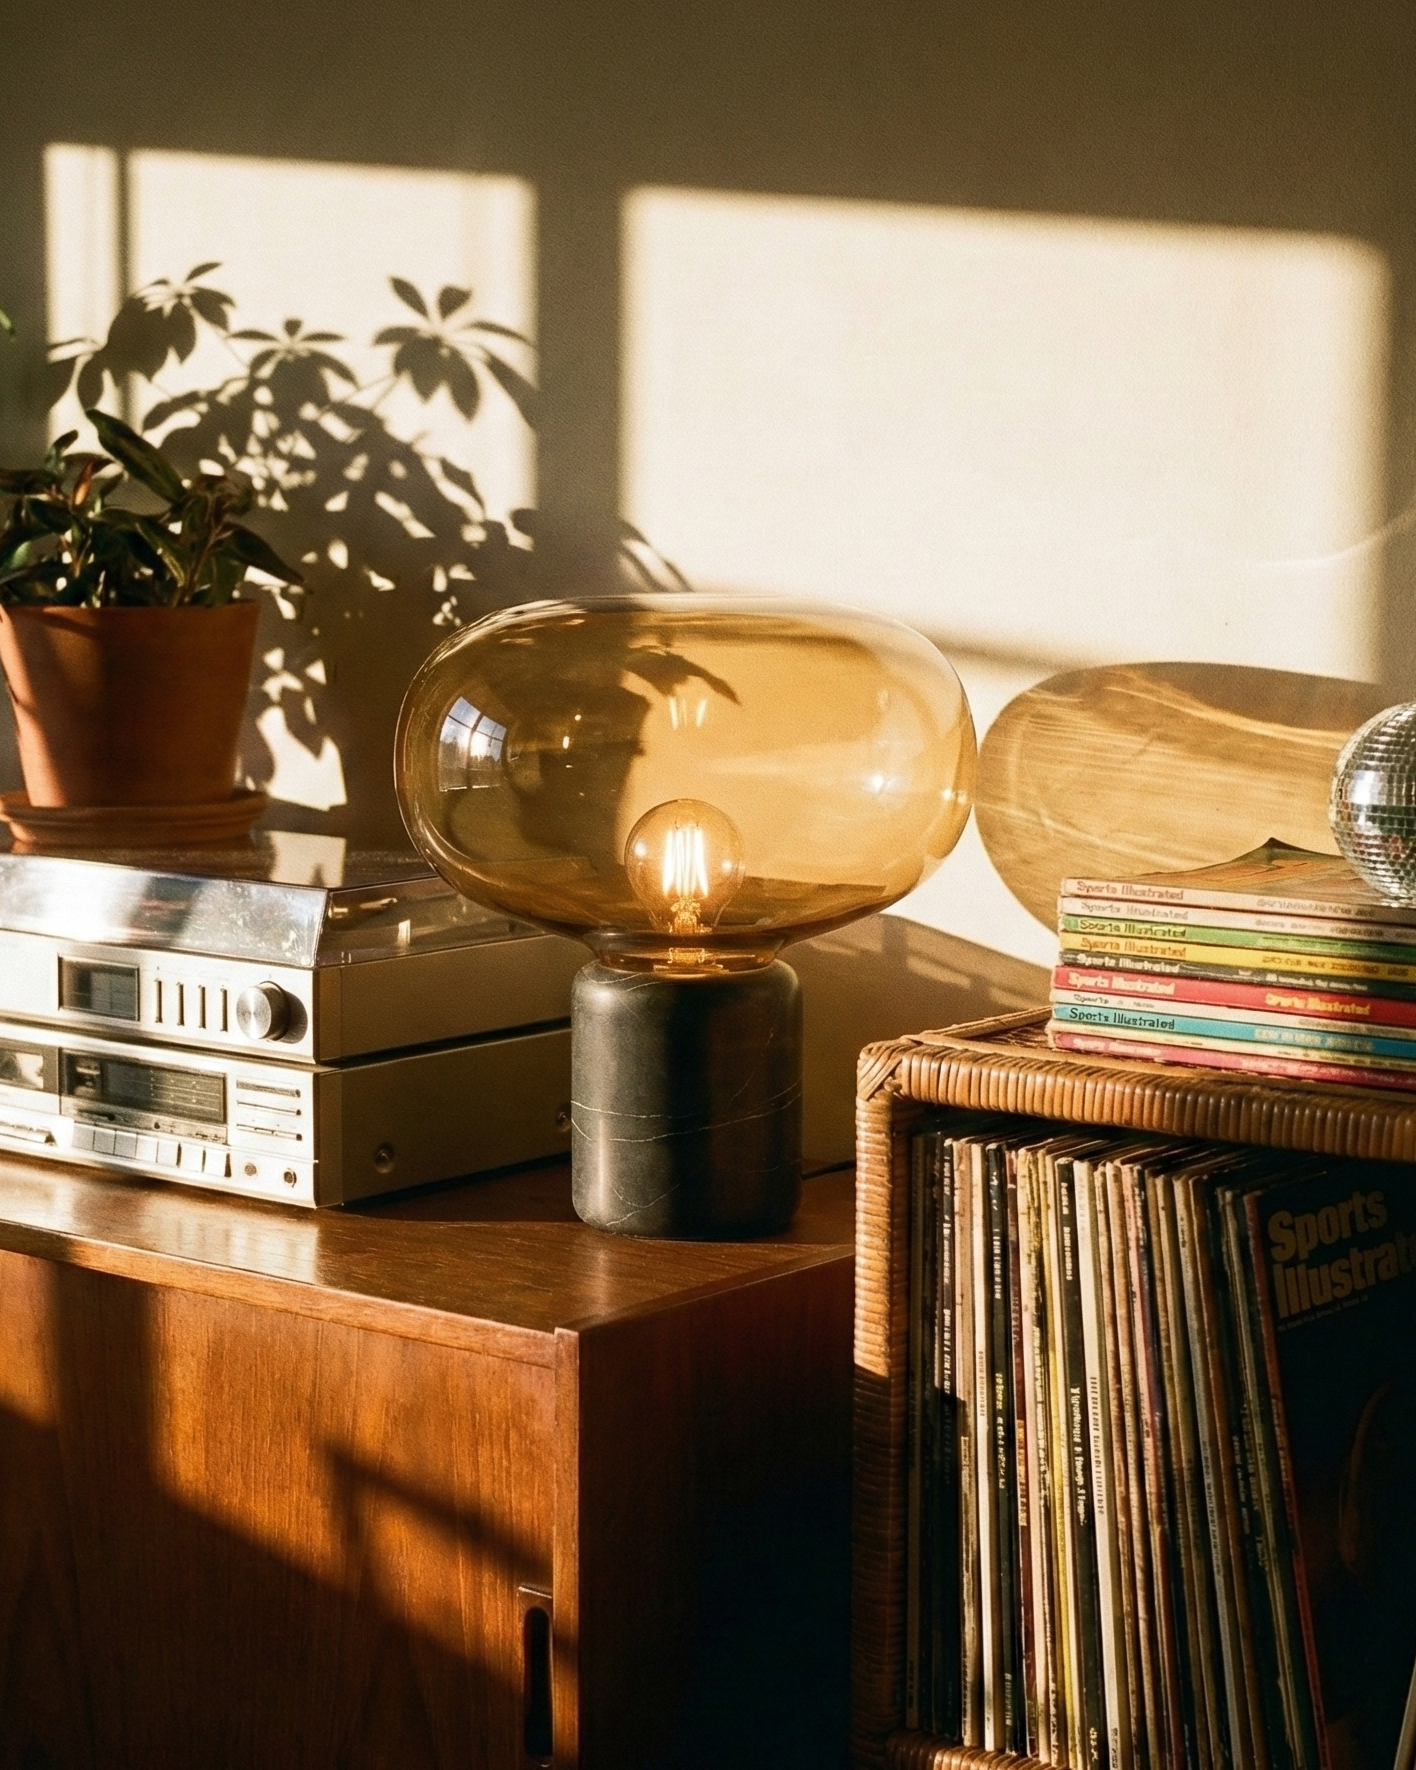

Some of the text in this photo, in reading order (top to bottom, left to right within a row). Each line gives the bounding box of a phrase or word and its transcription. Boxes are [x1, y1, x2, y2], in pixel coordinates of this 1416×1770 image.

[1077, 881, 1117, 895] Sports
[1069, 1008, 1110, 1023] Sports
[1267, 1190, 1388, 1261] Sports
